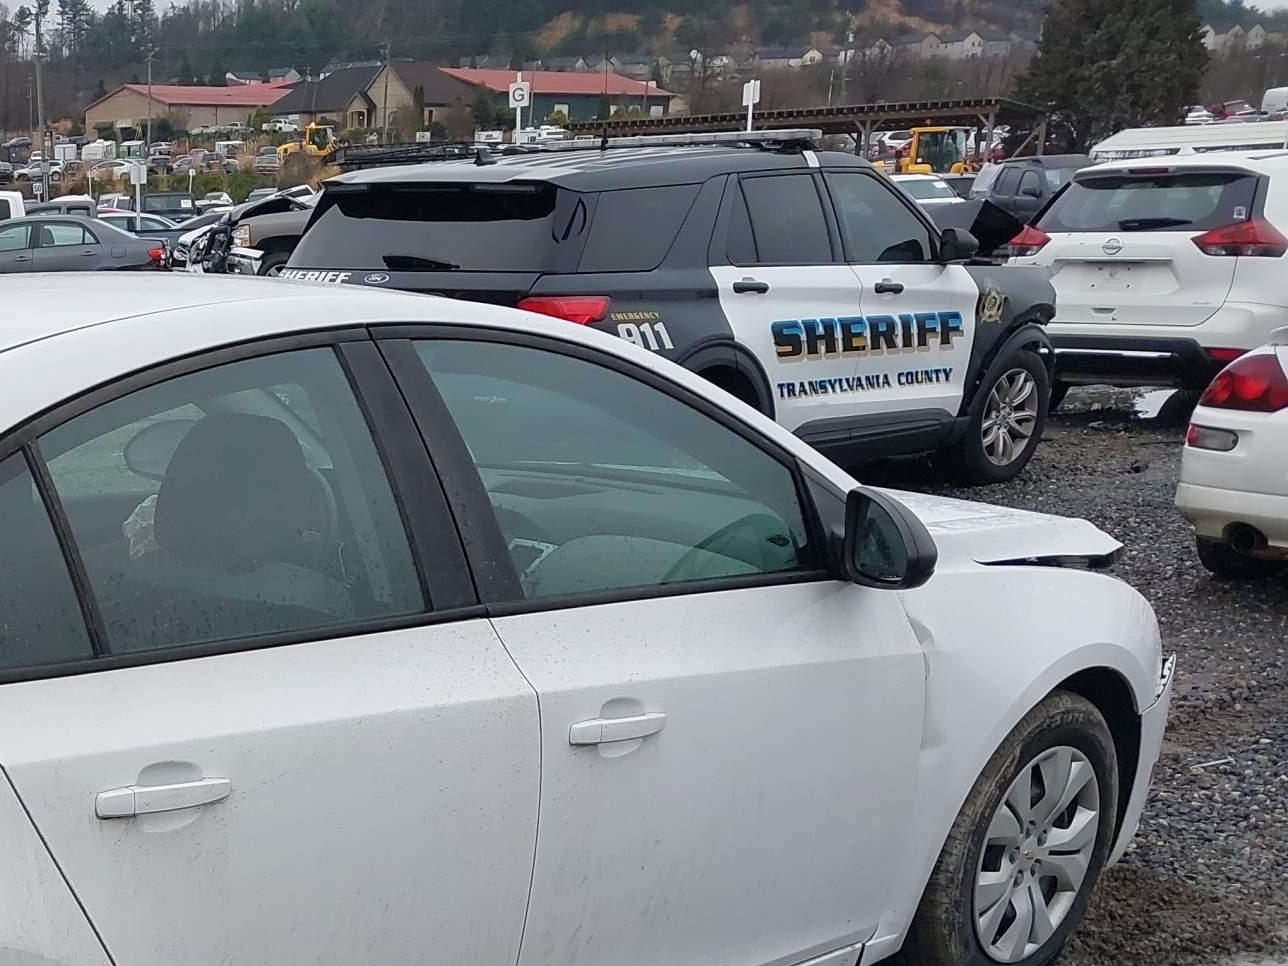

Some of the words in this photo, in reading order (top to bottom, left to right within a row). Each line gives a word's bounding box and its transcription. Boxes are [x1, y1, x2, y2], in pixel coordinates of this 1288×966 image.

[512, 87, 525, 102] G
[33, 184, 42, 192] 50
[611, 311, 660, 321] EMERGENCY
[617, 321, 675, 350] 911
[770, 311, 964, 362] SHERIFF
[777, 373, 891, 399] TRANSYLVANIA
[897, 367, 953, 387] COUNTY
